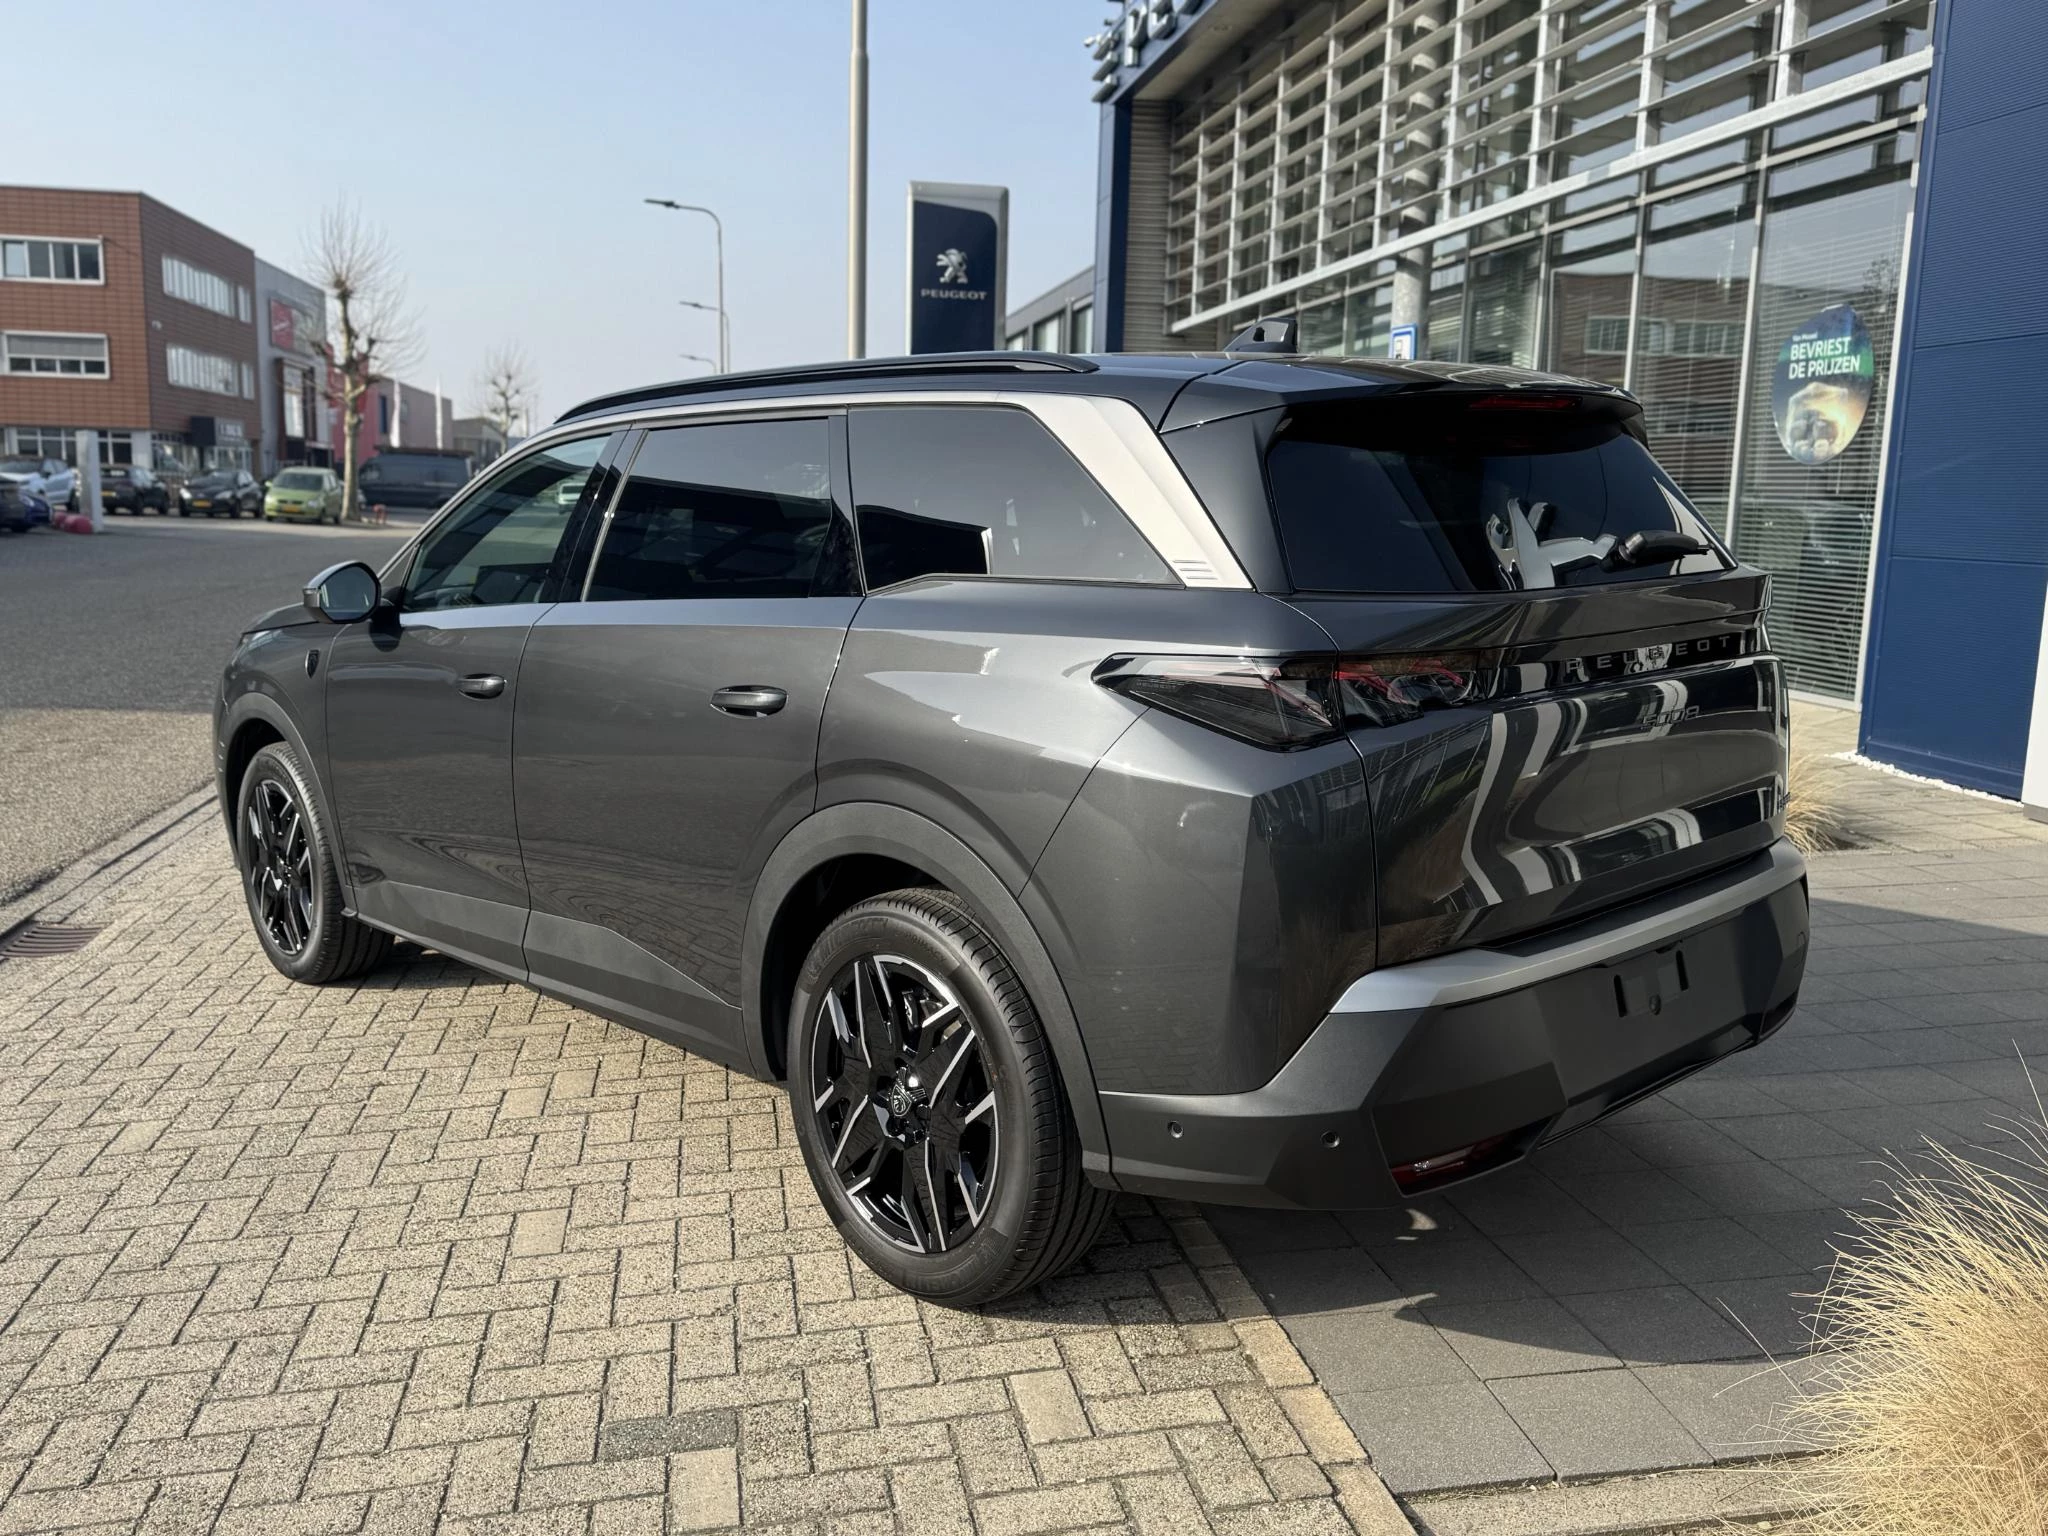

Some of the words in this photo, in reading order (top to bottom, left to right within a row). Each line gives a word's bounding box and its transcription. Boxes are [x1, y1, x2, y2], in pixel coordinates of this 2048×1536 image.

[920, 288, 987, 300] PEUGEOT
[1790, 336, 1852, 361] BEVRIEST
[1788, 361, 1806, 380] DE
[1807, 354, 1861, 377] PRIJZEN
[1566, 635, 1731, 674] PEUGEOT
